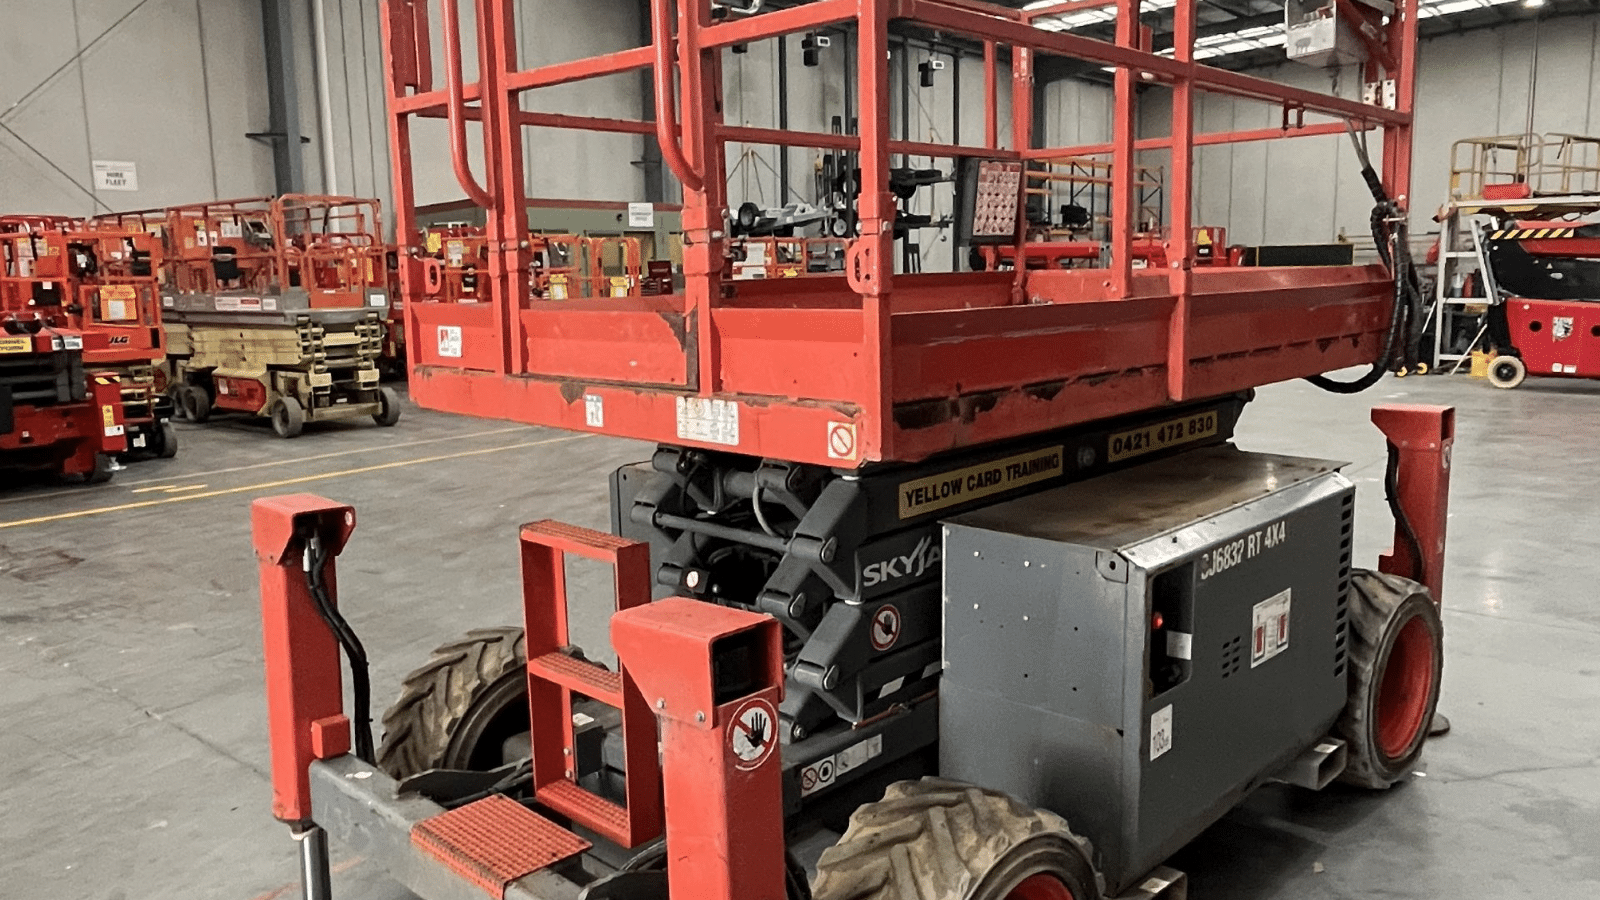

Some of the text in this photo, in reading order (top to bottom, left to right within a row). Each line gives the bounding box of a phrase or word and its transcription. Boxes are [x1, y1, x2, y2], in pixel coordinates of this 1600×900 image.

[1113, 415, 1213, 455] 0421 472 830
[906, 453, 1059, 508] YELLOW CARD TRAINING
[1248, 531, 1263, 559] RT
[1264, 520, 1286, 549] 4X4
